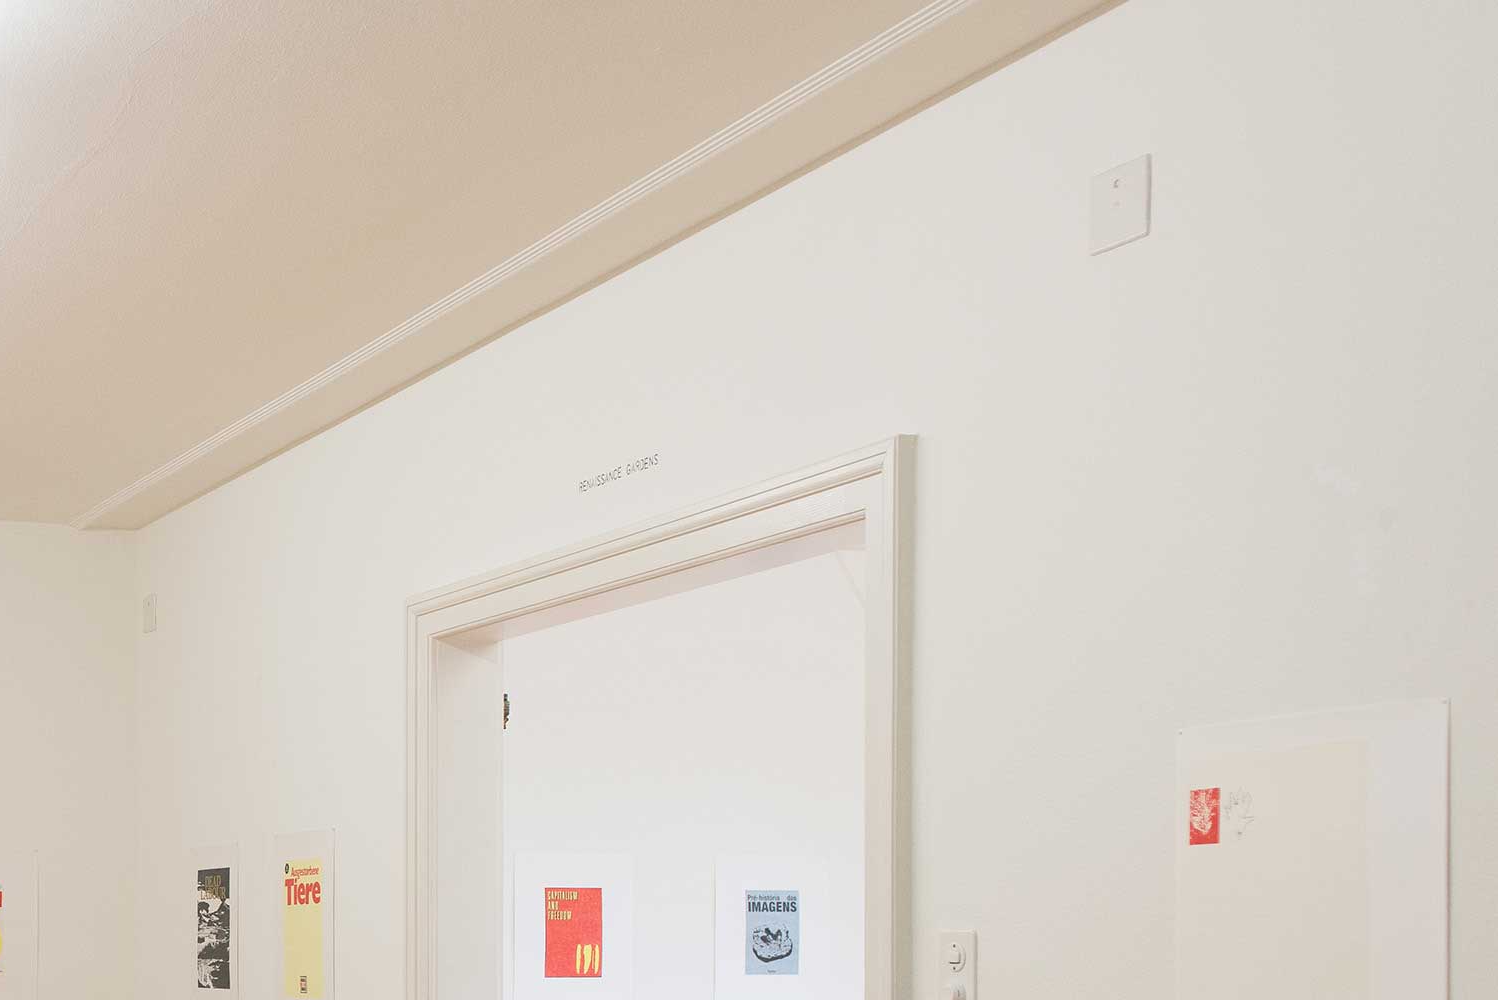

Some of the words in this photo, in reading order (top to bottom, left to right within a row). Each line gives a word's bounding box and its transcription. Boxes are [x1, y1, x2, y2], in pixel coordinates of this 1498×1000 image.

[626, 453, 659, 476] GARDENS
[285, 878, 321, 906] Tiere
[748, 901, 798, 912] IMAGENS
